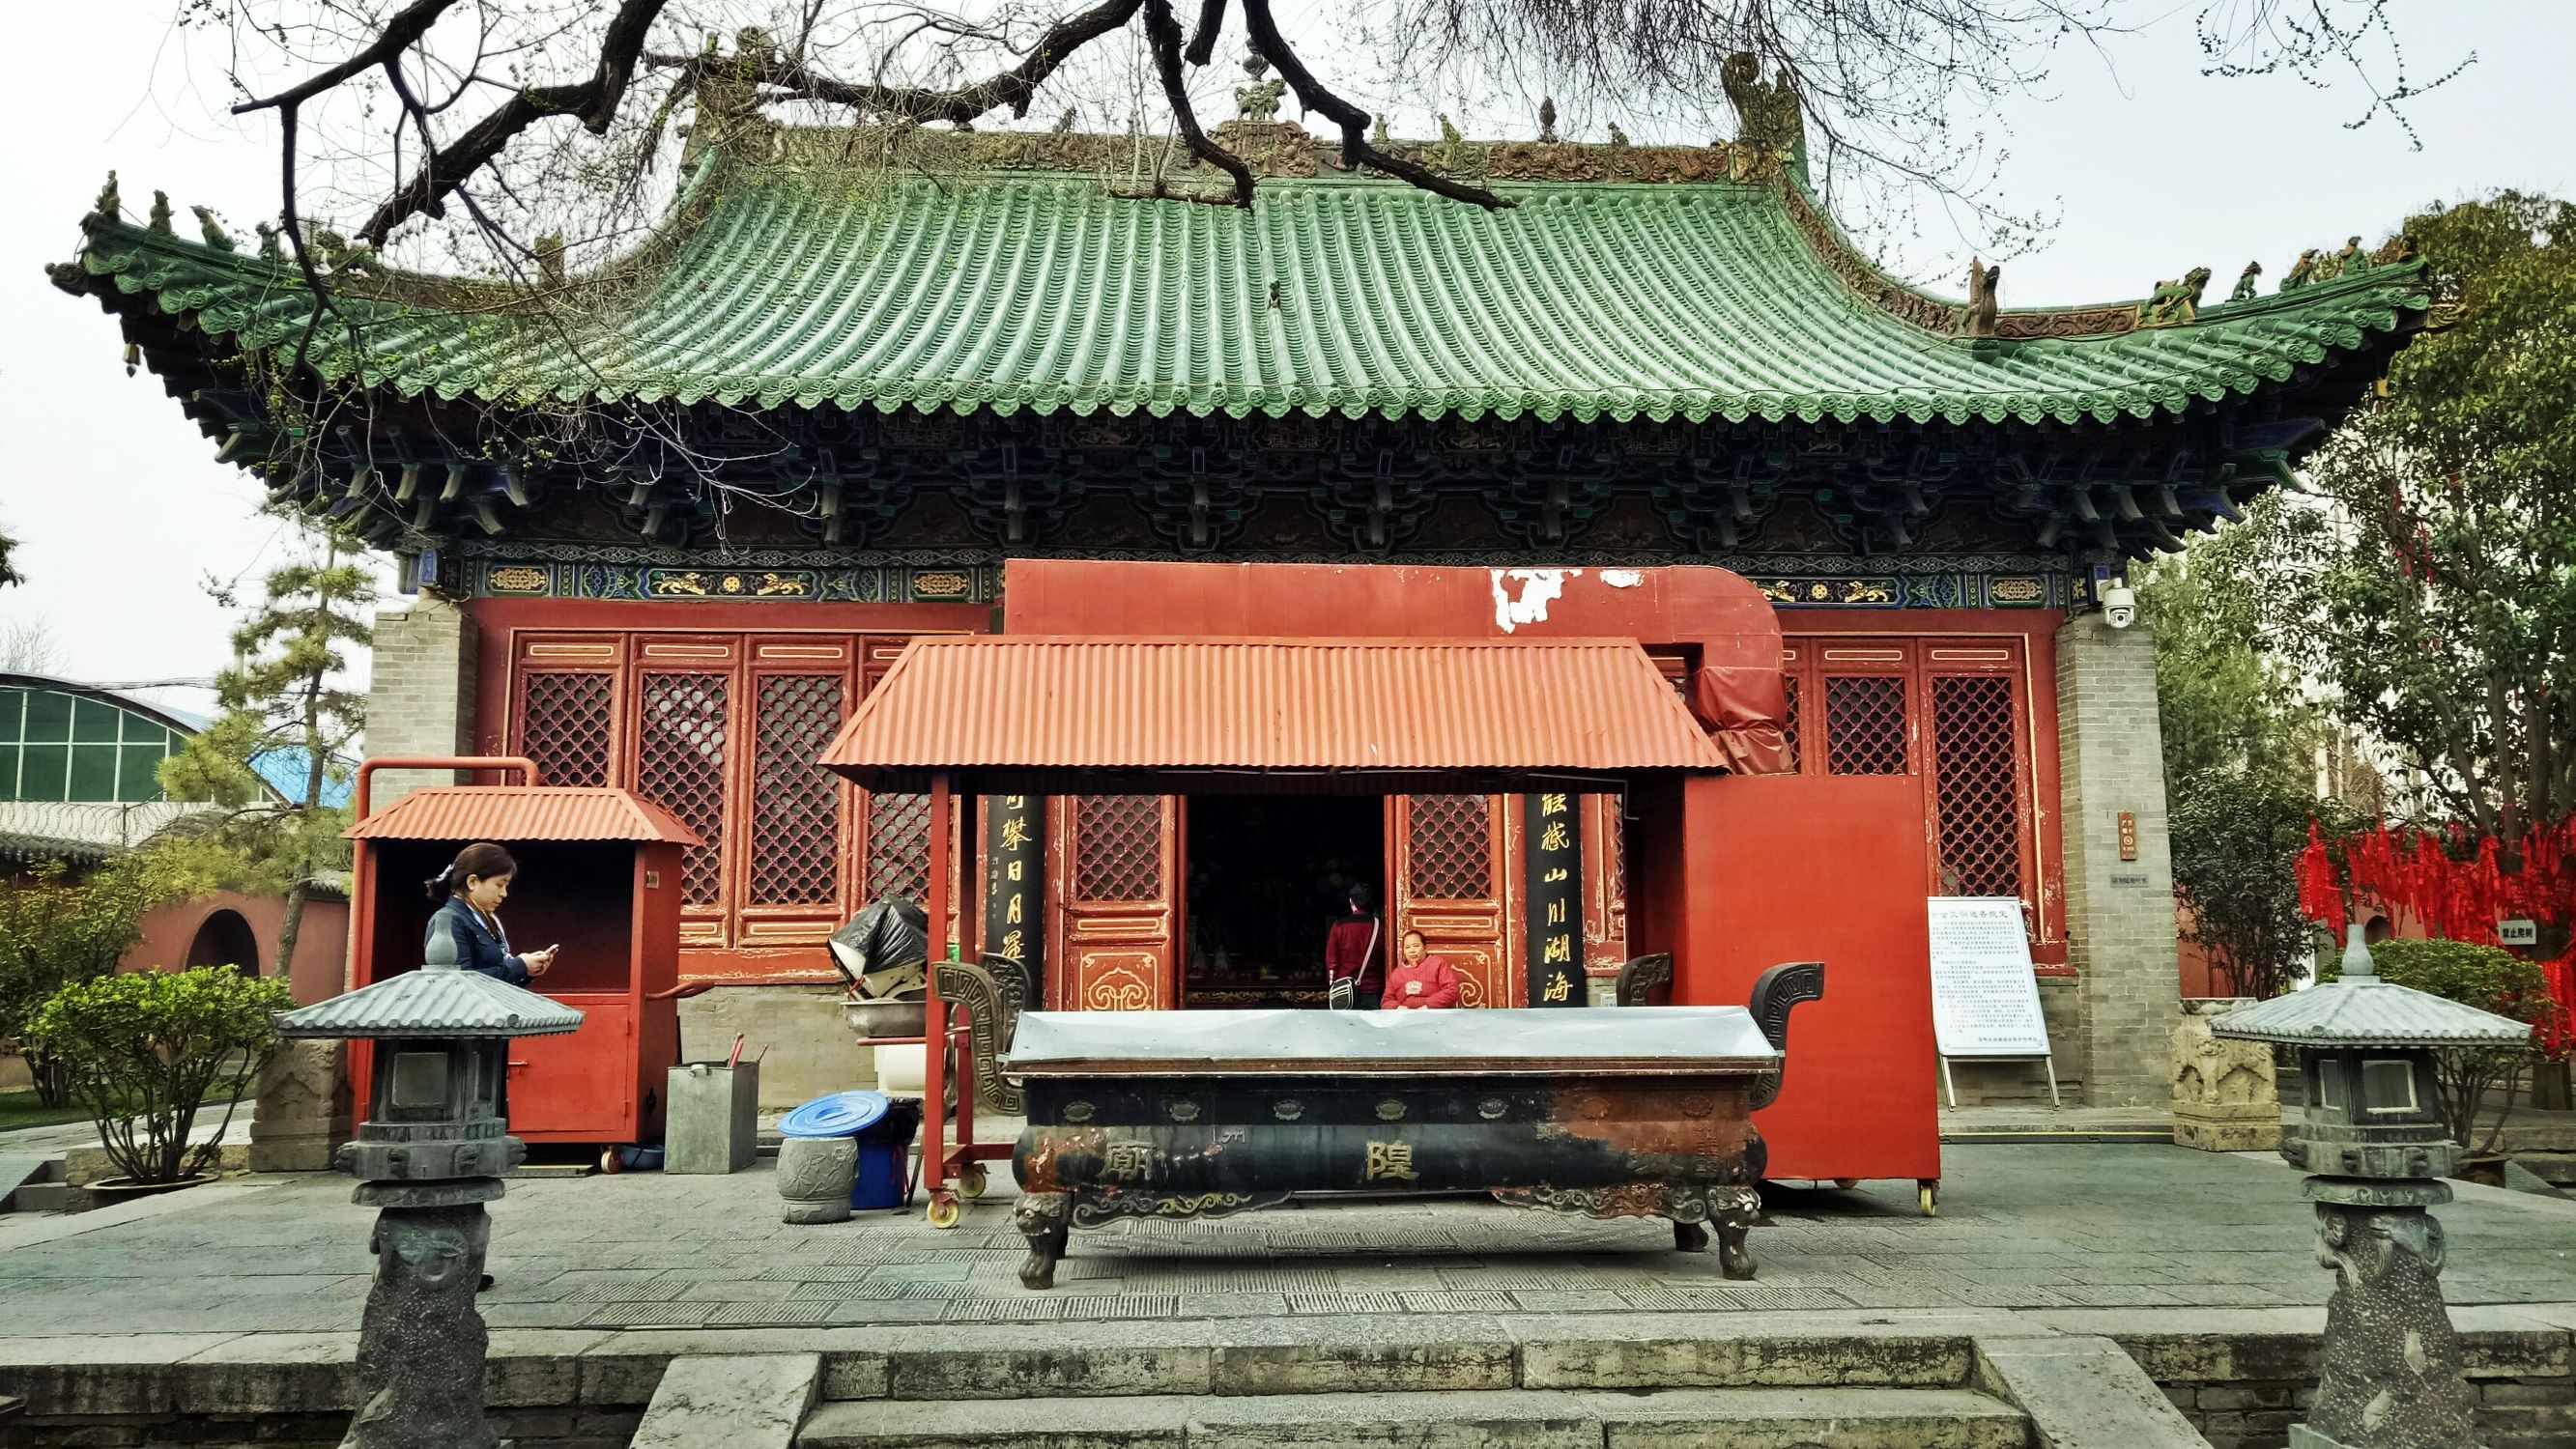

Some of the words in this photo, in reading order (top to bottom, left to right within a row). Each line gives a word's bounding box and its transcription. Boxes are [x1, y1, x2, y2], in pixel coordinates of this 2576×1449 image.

[2503, 927, 2533, 938] 禁止爬树
[1366, 1139, 1420, 1180] 隍
